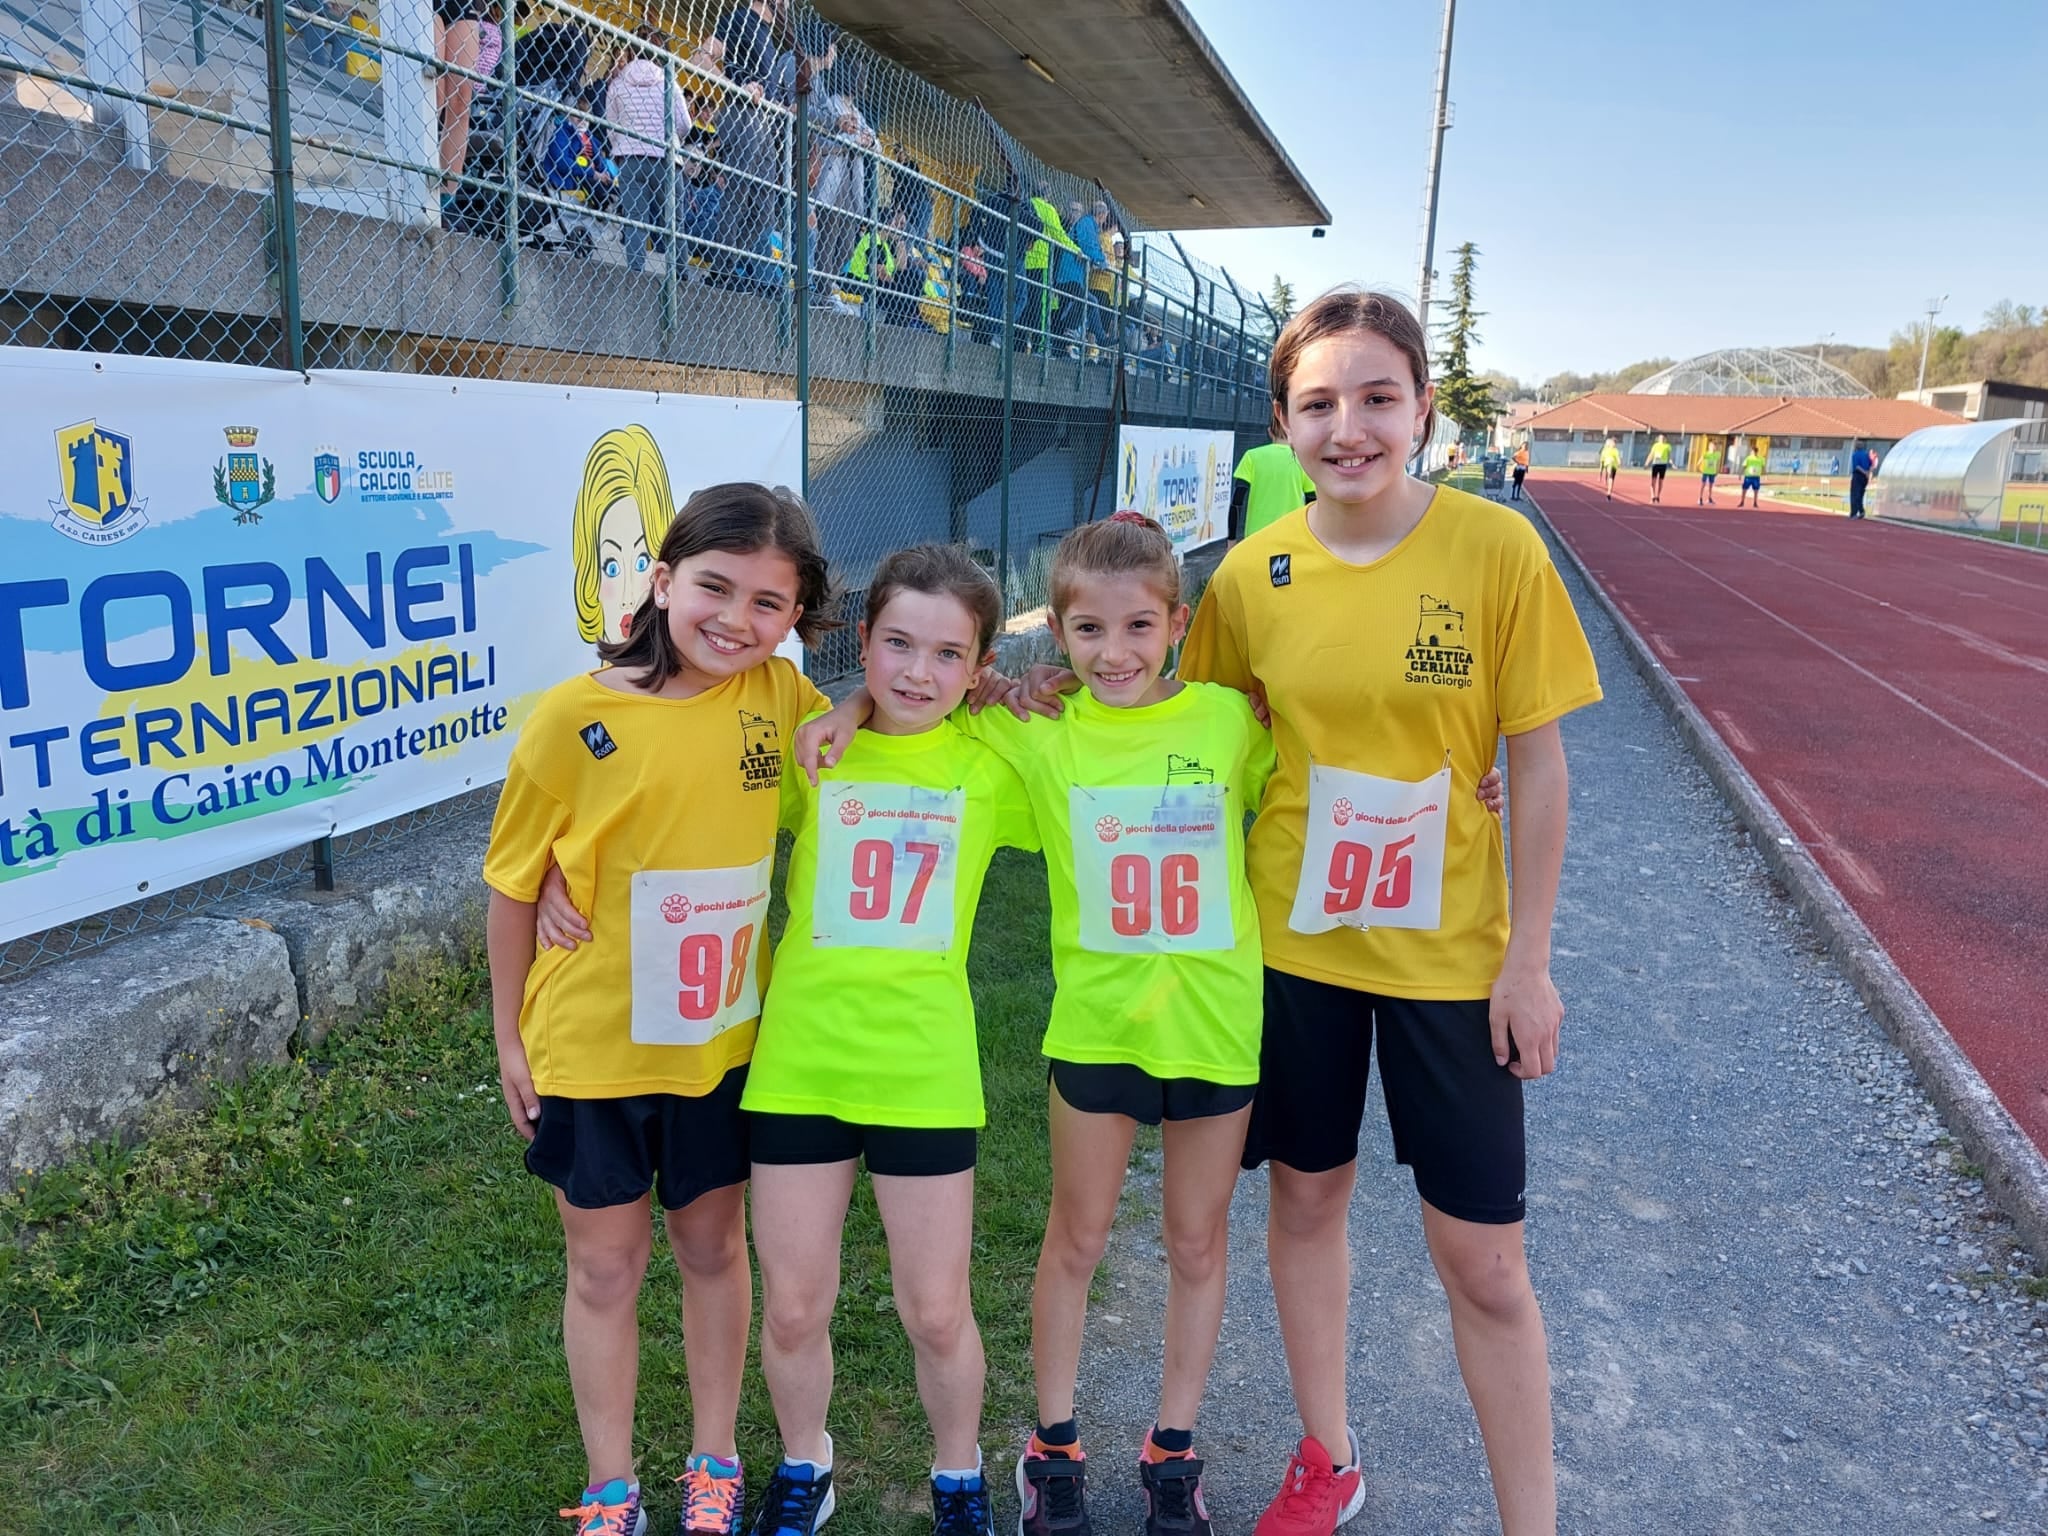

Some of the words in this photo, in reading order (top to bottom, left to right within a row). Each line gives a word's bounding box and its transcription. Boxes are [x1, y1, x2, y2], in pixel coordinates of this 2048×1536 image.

[358, 451, 415, 469] SCUOLA
[360, 472, 411, 490] CALCIO
[82, 528, 126, 542] CAIRESE
[0, 543, 476, 710] TORNEI
[1405, 648, 1474, 664] ATLETICA
[1410, 660, 1469, 675] CERIALE
[1404, 672, 1429, 684] San
[1431, 674, 1473, 690] Giorgio
[0, 646, 496, 796] TERNAZIONALI
[76, 788, 135, 847] di
[151, 763, 292, 824] Cairo
[302, 700, 508, 789] Montenotte
[742, 781, 763, 792] San
[867, 809, 896, 820] giochi
[897, 809, 920, 819] della
[921, 810, 957, 824] gioventù
[1355, 811, 1384, 825] giochi
[1385, 815, 1407, 825] della
[1125, 822, 1153, 835] giochi
[1154, 822, 1177, 833] della
[1178, 822, 1215, 835] gioventù
[849, 839, 940, 925] 97
[1323, 833, 1416, 915] 95
[1111, 853, 1199, 936] 96
[694, 901, 725, 914] giochi
[678, 923, 754, 1021] 98
